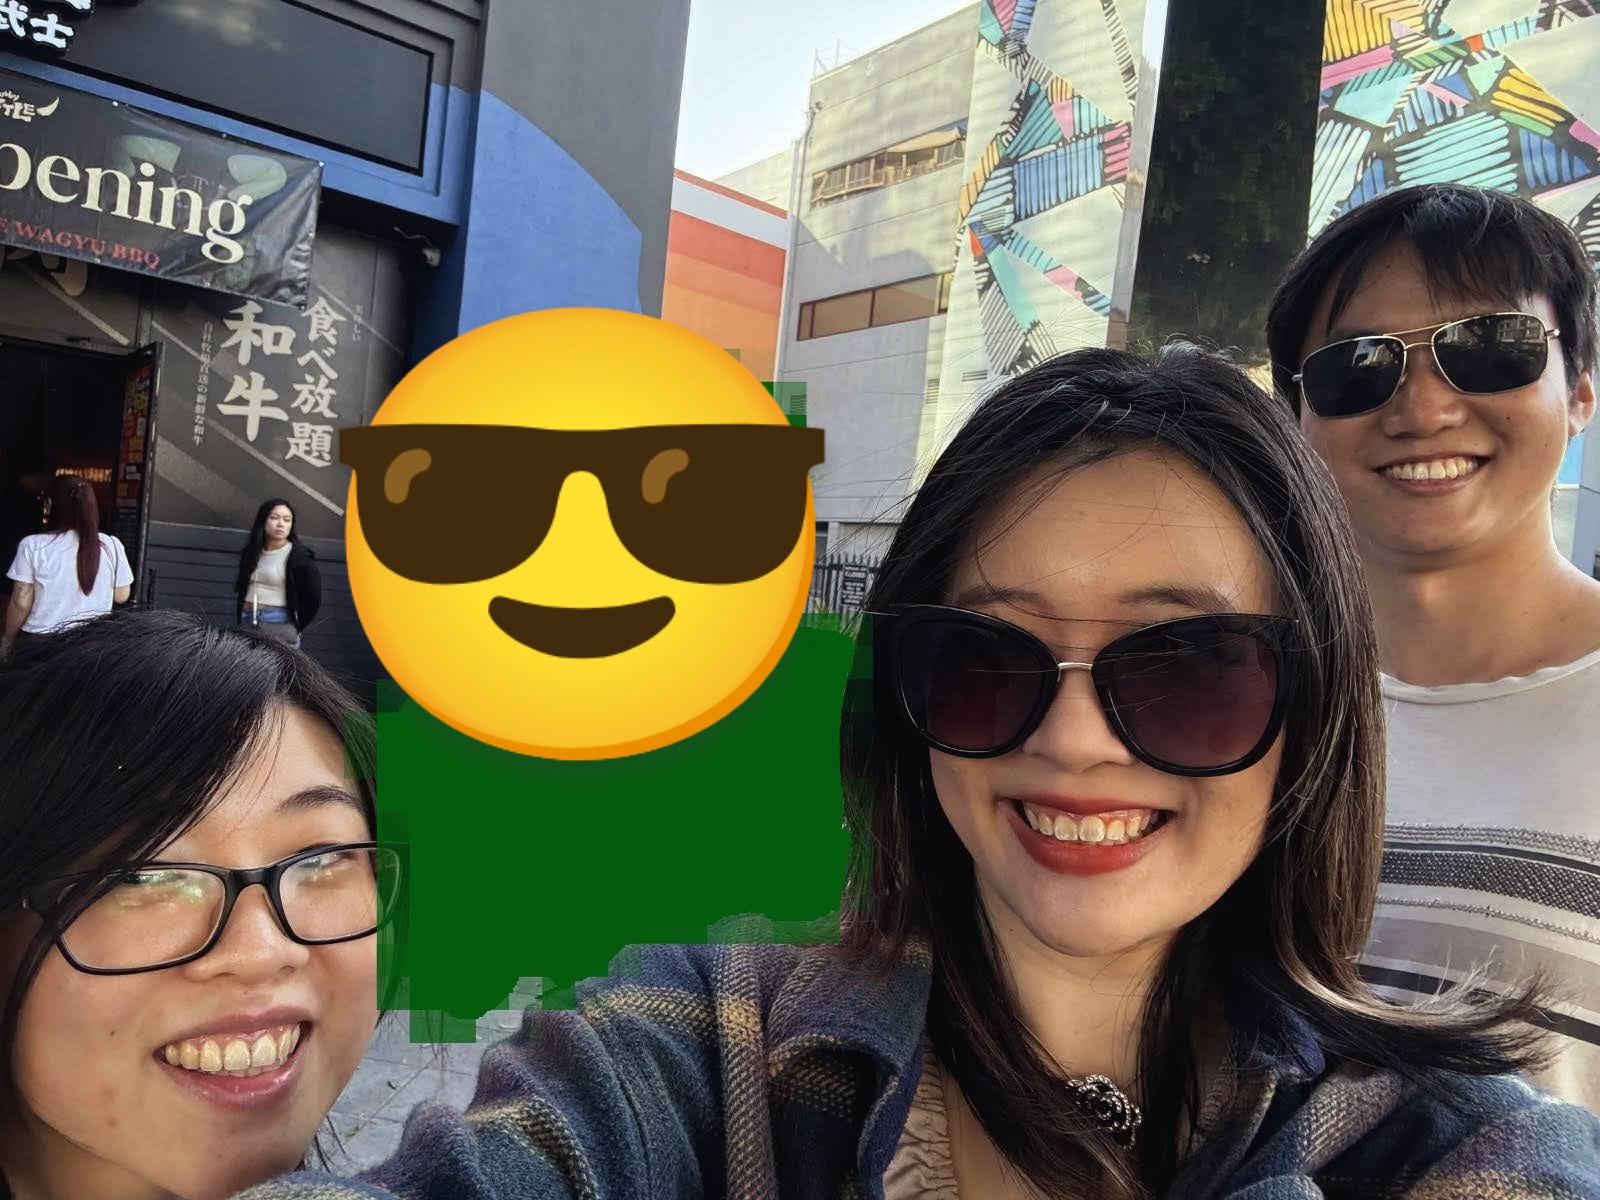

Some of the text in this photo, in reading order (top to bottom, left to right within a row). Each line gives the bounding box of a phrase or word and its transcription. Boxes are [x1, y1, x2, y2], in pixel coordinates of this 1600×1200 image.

[0, 98, 36, 122] TLE
[16, 220, 105, 255] WAGYU
[112, 241, 160, 271] BBQ
[217, 300, 296, 442] 和牛
[284, 296, 347, 468] 食べ放題
